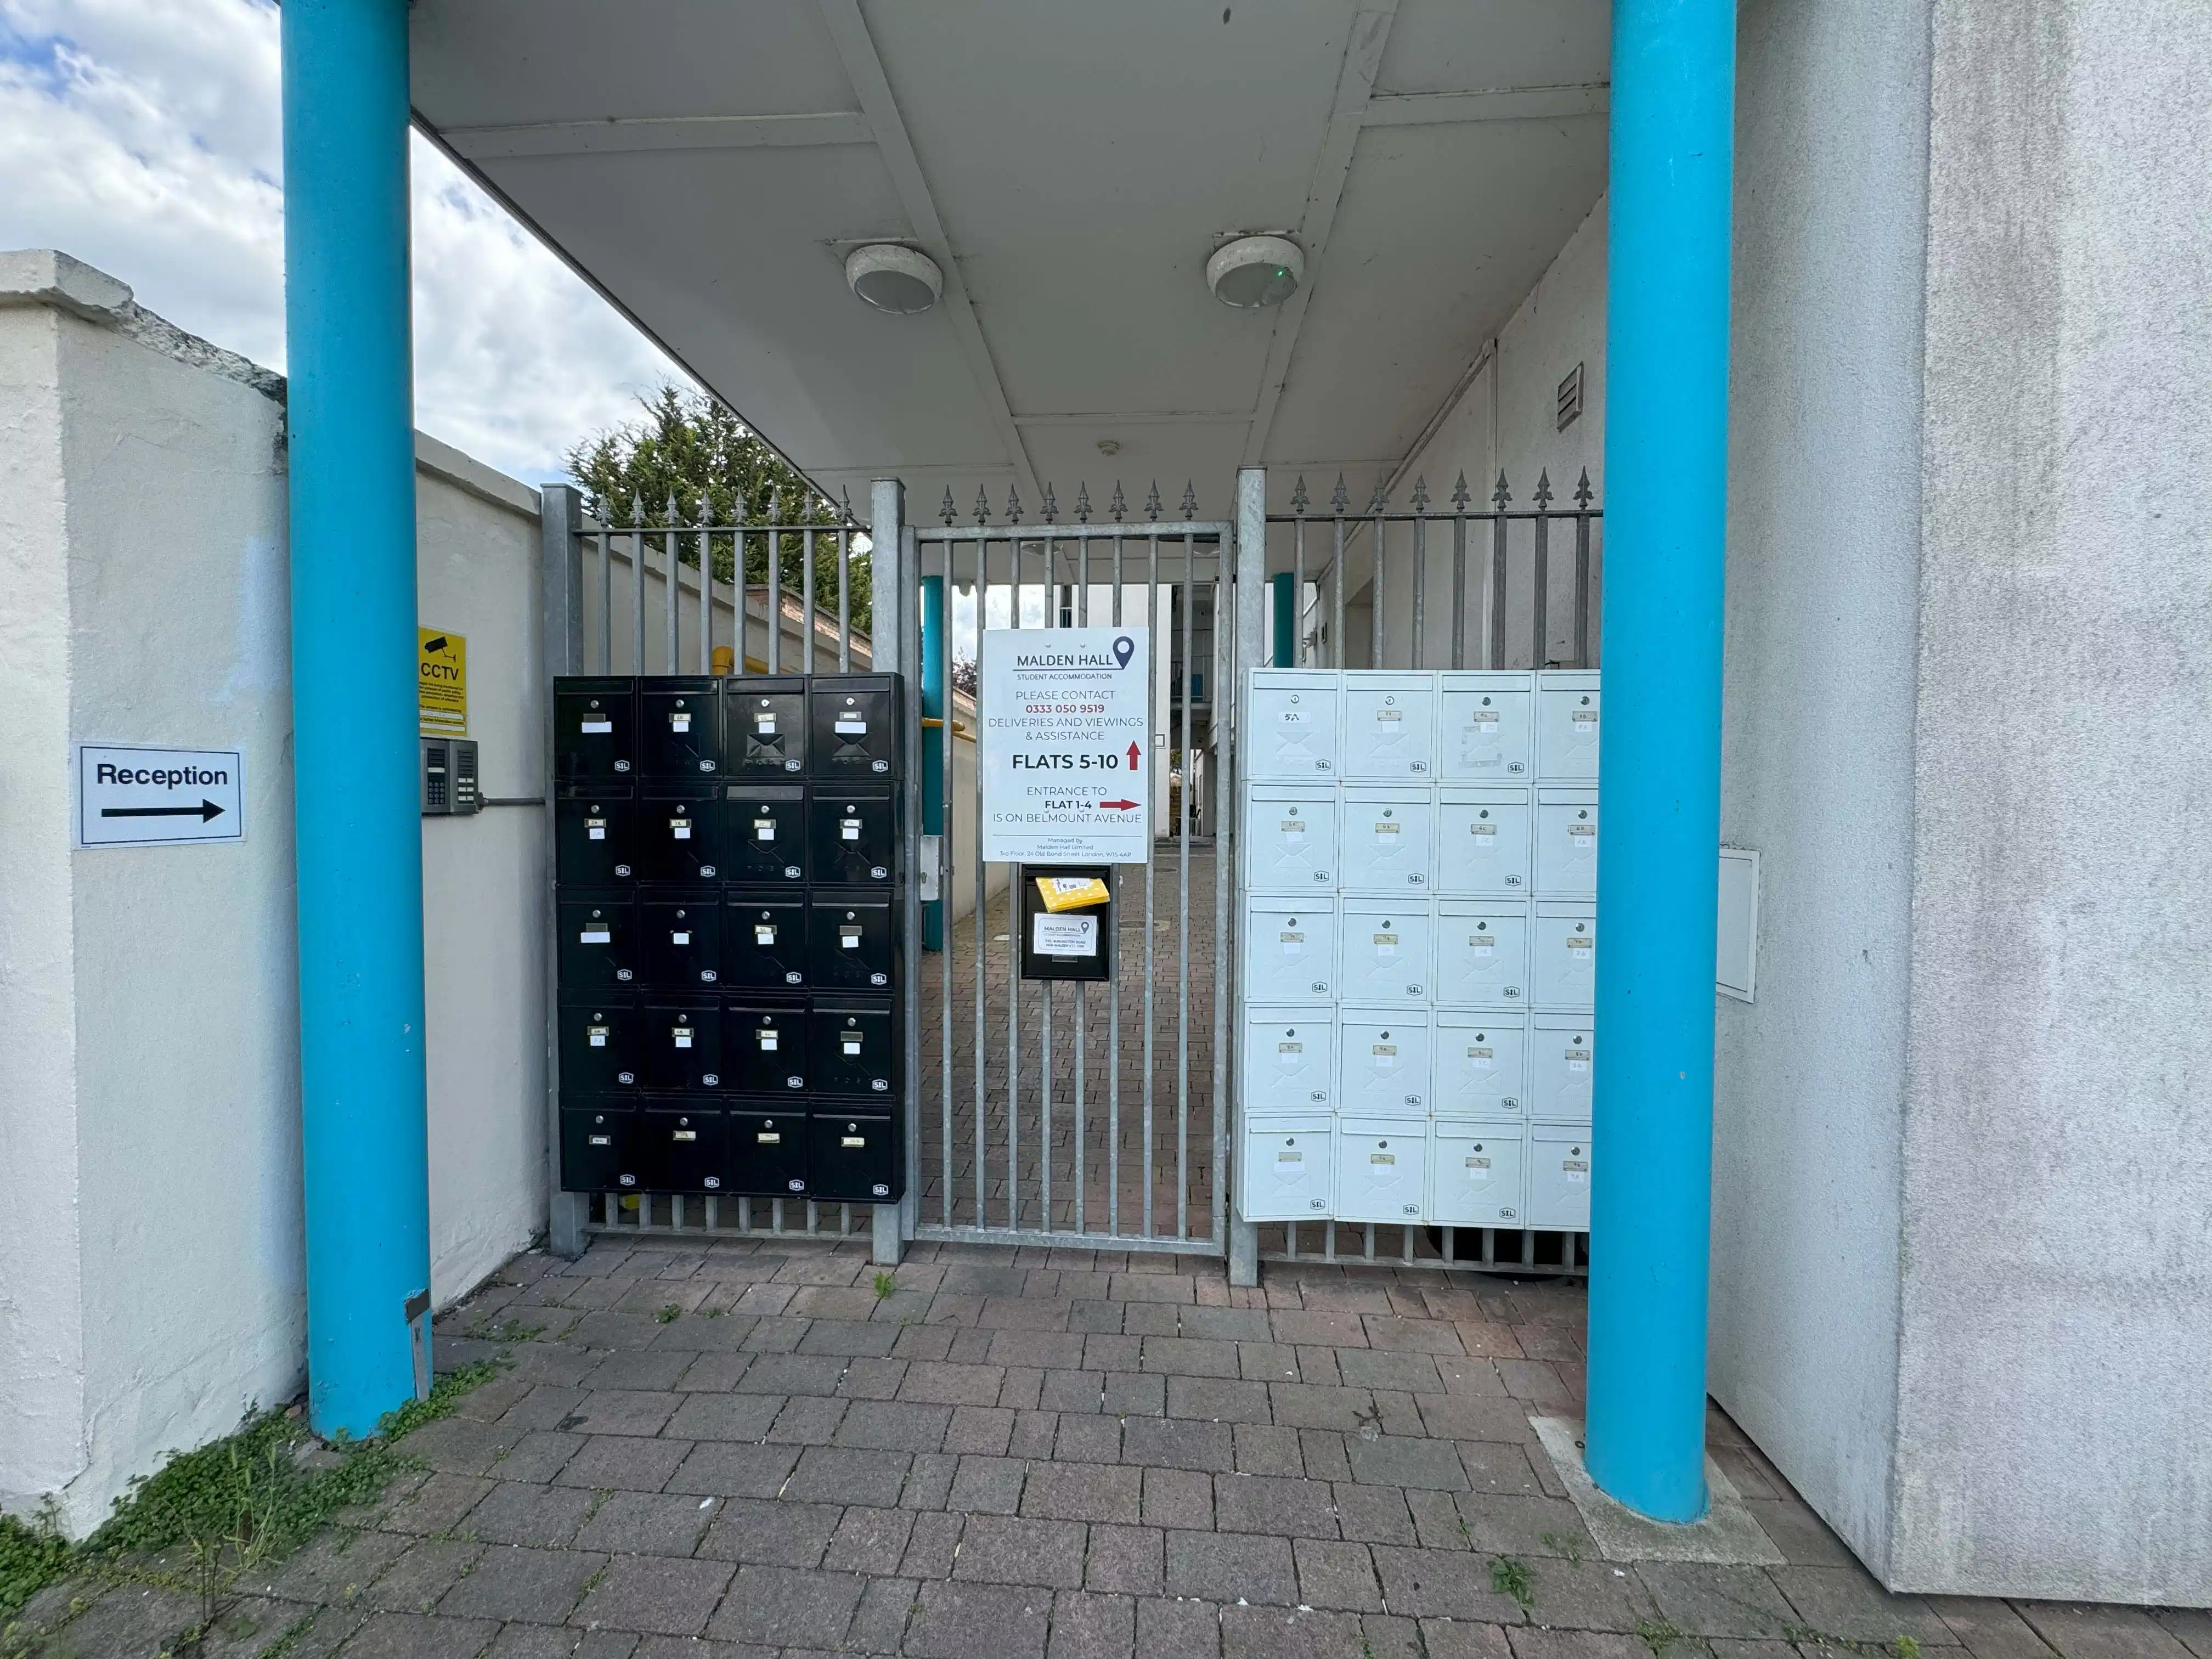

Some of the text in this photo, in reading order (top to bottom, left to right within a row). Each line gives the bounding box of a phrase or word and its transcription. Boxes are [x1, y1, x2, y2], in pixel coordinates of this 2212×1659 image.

[1017, 654, 1113, 665] MALDEN HALL
[421, 662, 459, 681] CCTV
[1015, 690, 1115, 700] PLEASE CONTACT
[1026, 704, 1105, 713] 0333 050 9519
[989, 718, 1143, 727] DELIVERIES AND VIEWINGS
[1025, 731, 1105, 741] & ASSISTANCE
[1013, 754, 1118, 770] FLATS 5-10
[97, 764, 228, 789] Reception
[1027, 787, 1107, 796] ENTRANCE TO
[1045, 800, 1092, 809] FLAT 1-4
[993, 814, 1142, 823] IS ON BELMOUNT AVENUE
